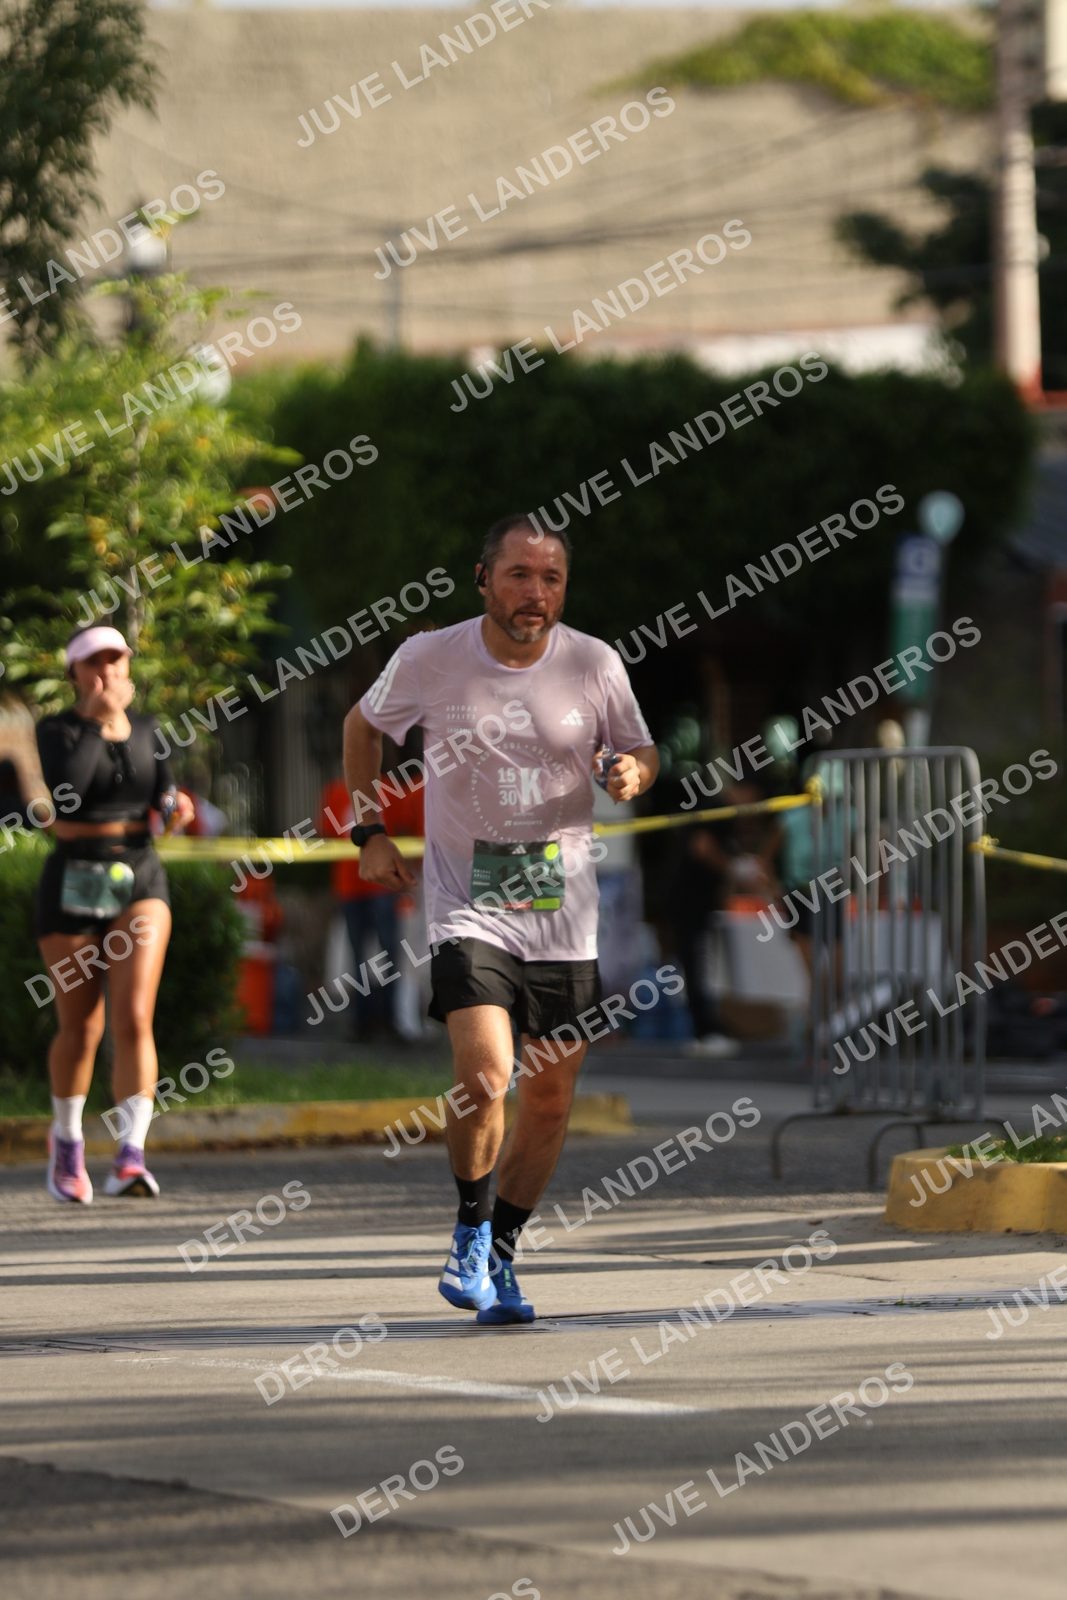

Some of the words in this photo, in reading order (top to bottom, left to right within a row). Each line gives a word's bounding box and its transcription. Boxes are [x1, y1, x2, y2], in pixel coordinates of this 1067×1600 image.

[497, 767, 516, 783] 15
[520, 767, 545, 806] K
[499, 790, 517, 806] 30
